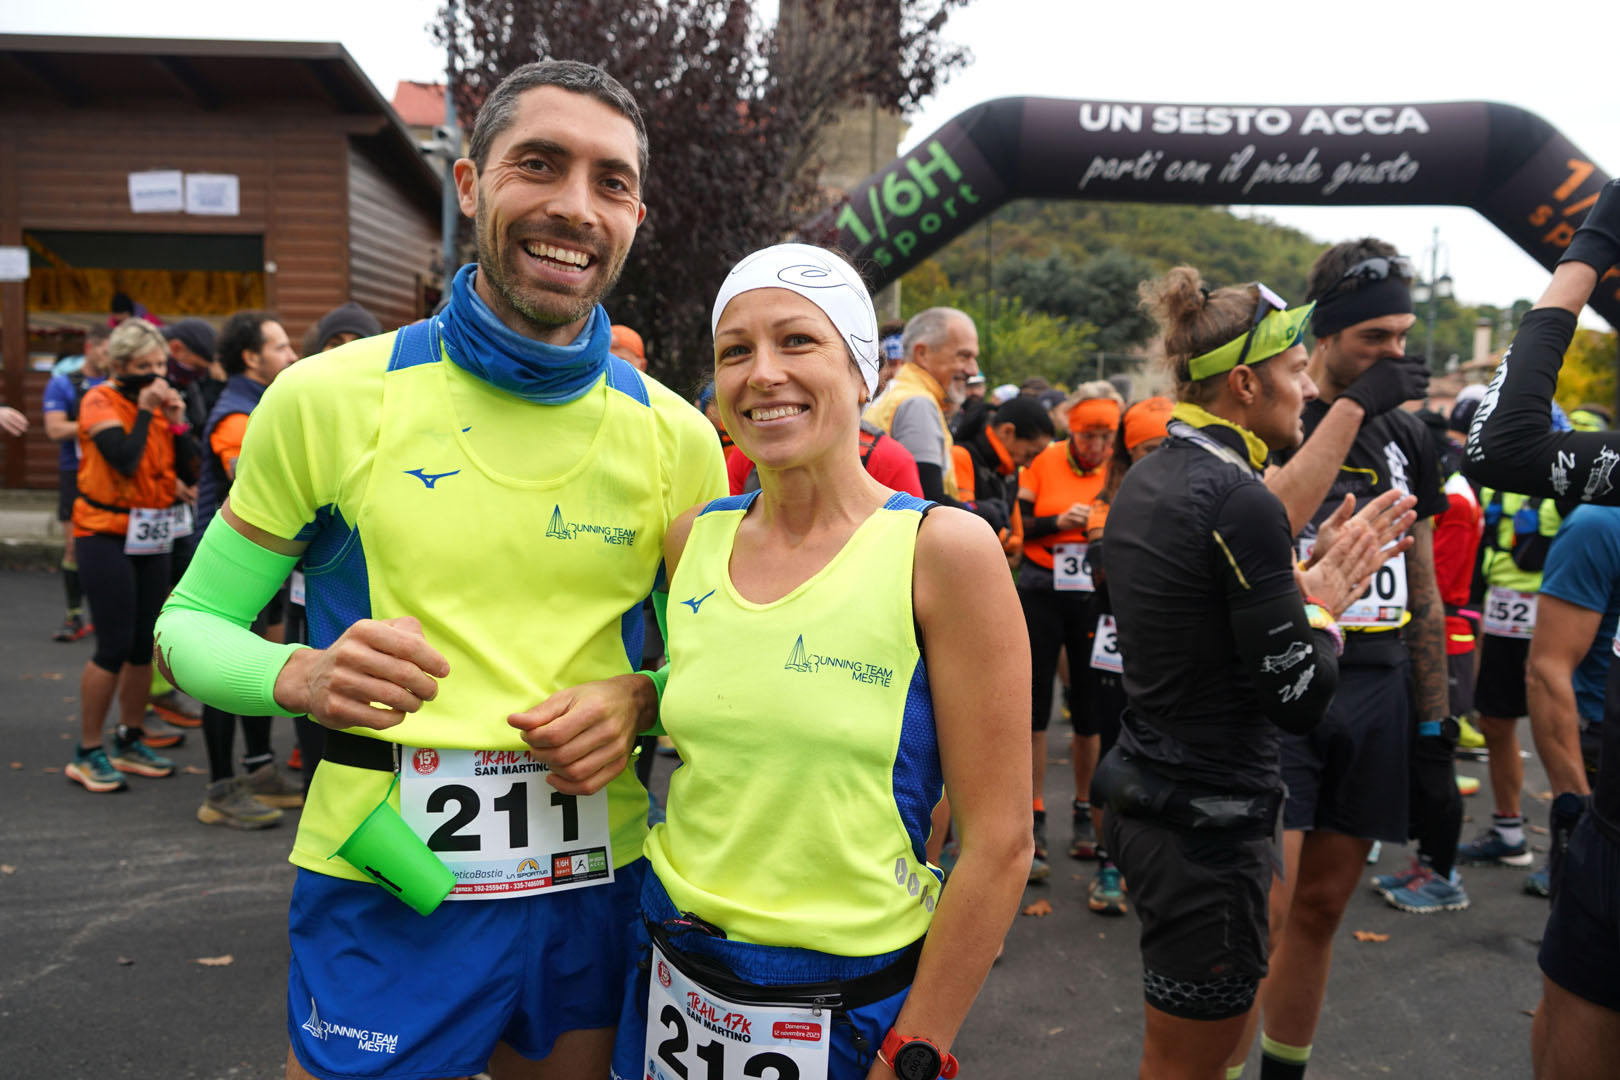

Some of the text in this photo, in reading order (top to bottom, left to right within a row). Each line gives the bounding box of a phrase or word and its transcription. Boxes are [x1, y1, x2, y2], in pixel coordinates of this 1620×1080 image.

[1079, 103, 1430, 135] UN SESTO ACCA
[1078, 144, 1419, 196] parti con il piede giusto
[835, 139, 962, 245] 1/6H
[873, 183, 980, 268] sport
[613, 527, 636, 538] TEAM
[865, 663, 893, 679] TEAM
[474, 750, 521, 766] TRAIL
[475, 766, 498, 777] SAN
[426, 782, 579, 852] 211
[686, 1007, 751, 1043] SAN MARTINO
[687, 991, 721, 1022] TRAIL
[722, 1012, 753, 1035] 17K
[318, 1019, 399, 1044] RUNNING TEAM
[780, 1029, 806, 1039] novembre
[785, 1022, 811, 1031] Domenica
[357, 1040, 397, 1054] MESTRE
